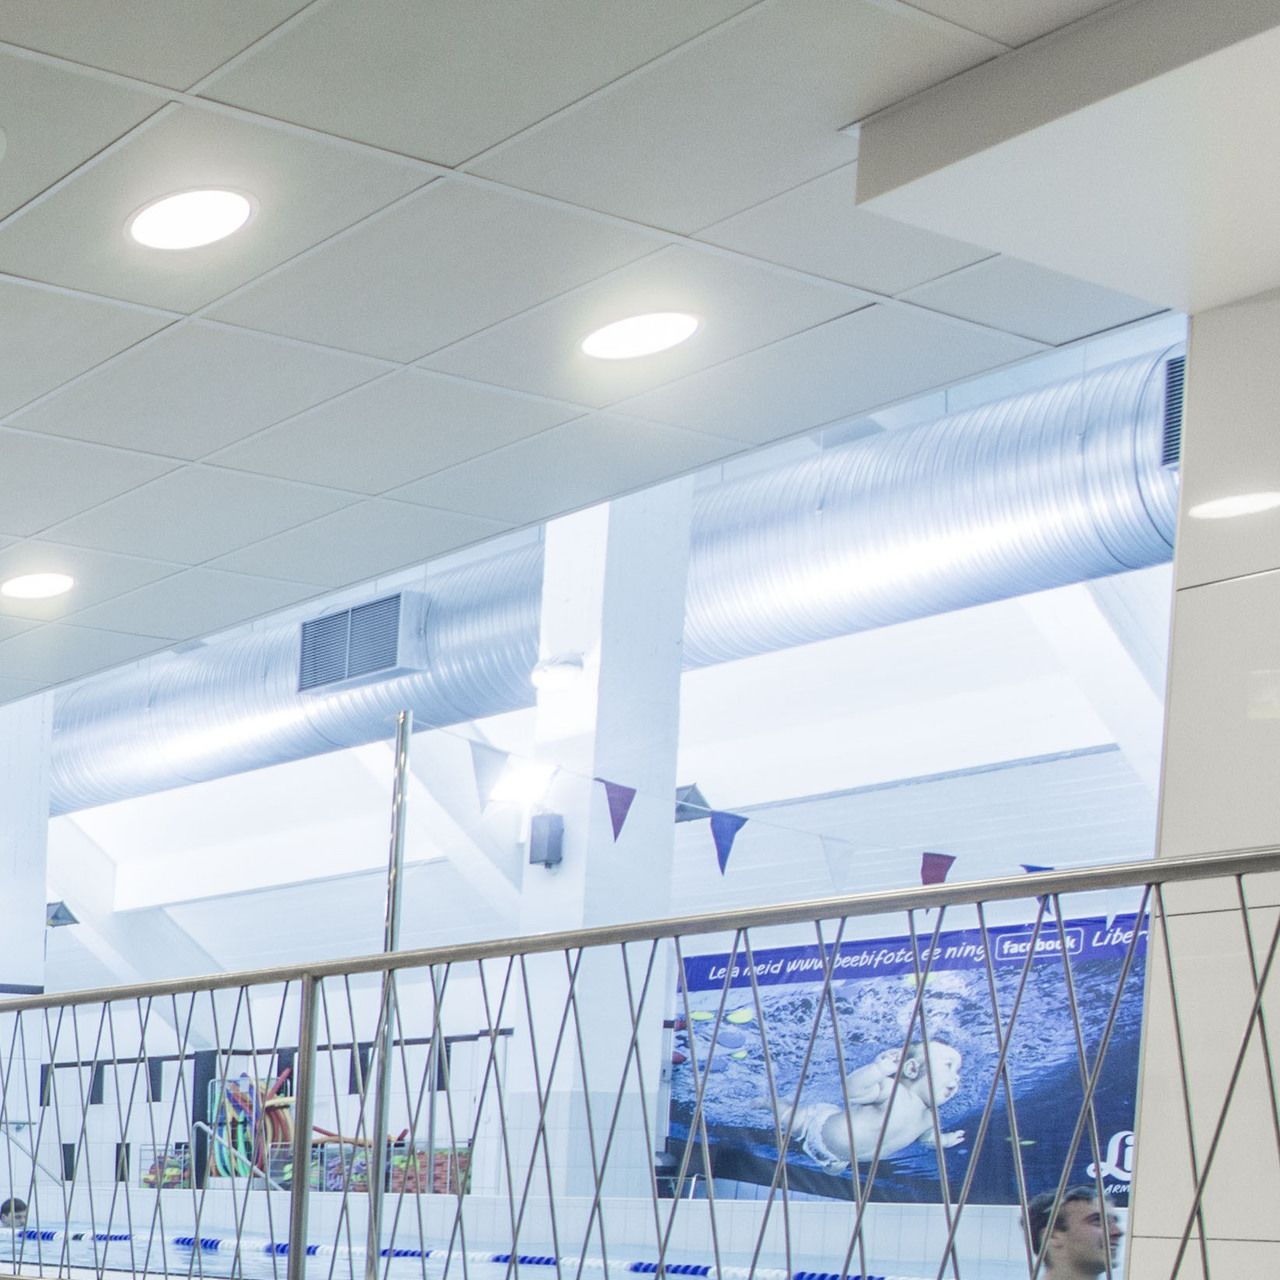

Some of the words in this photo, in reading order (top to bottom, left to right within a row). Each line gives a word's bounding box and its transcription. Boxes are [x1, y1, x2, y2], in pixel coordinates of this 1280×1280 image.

[708, 965, 740, 980] Lea
[944, 942, 986, 962] ning
[1091, 927, 1149, 947] Liber
